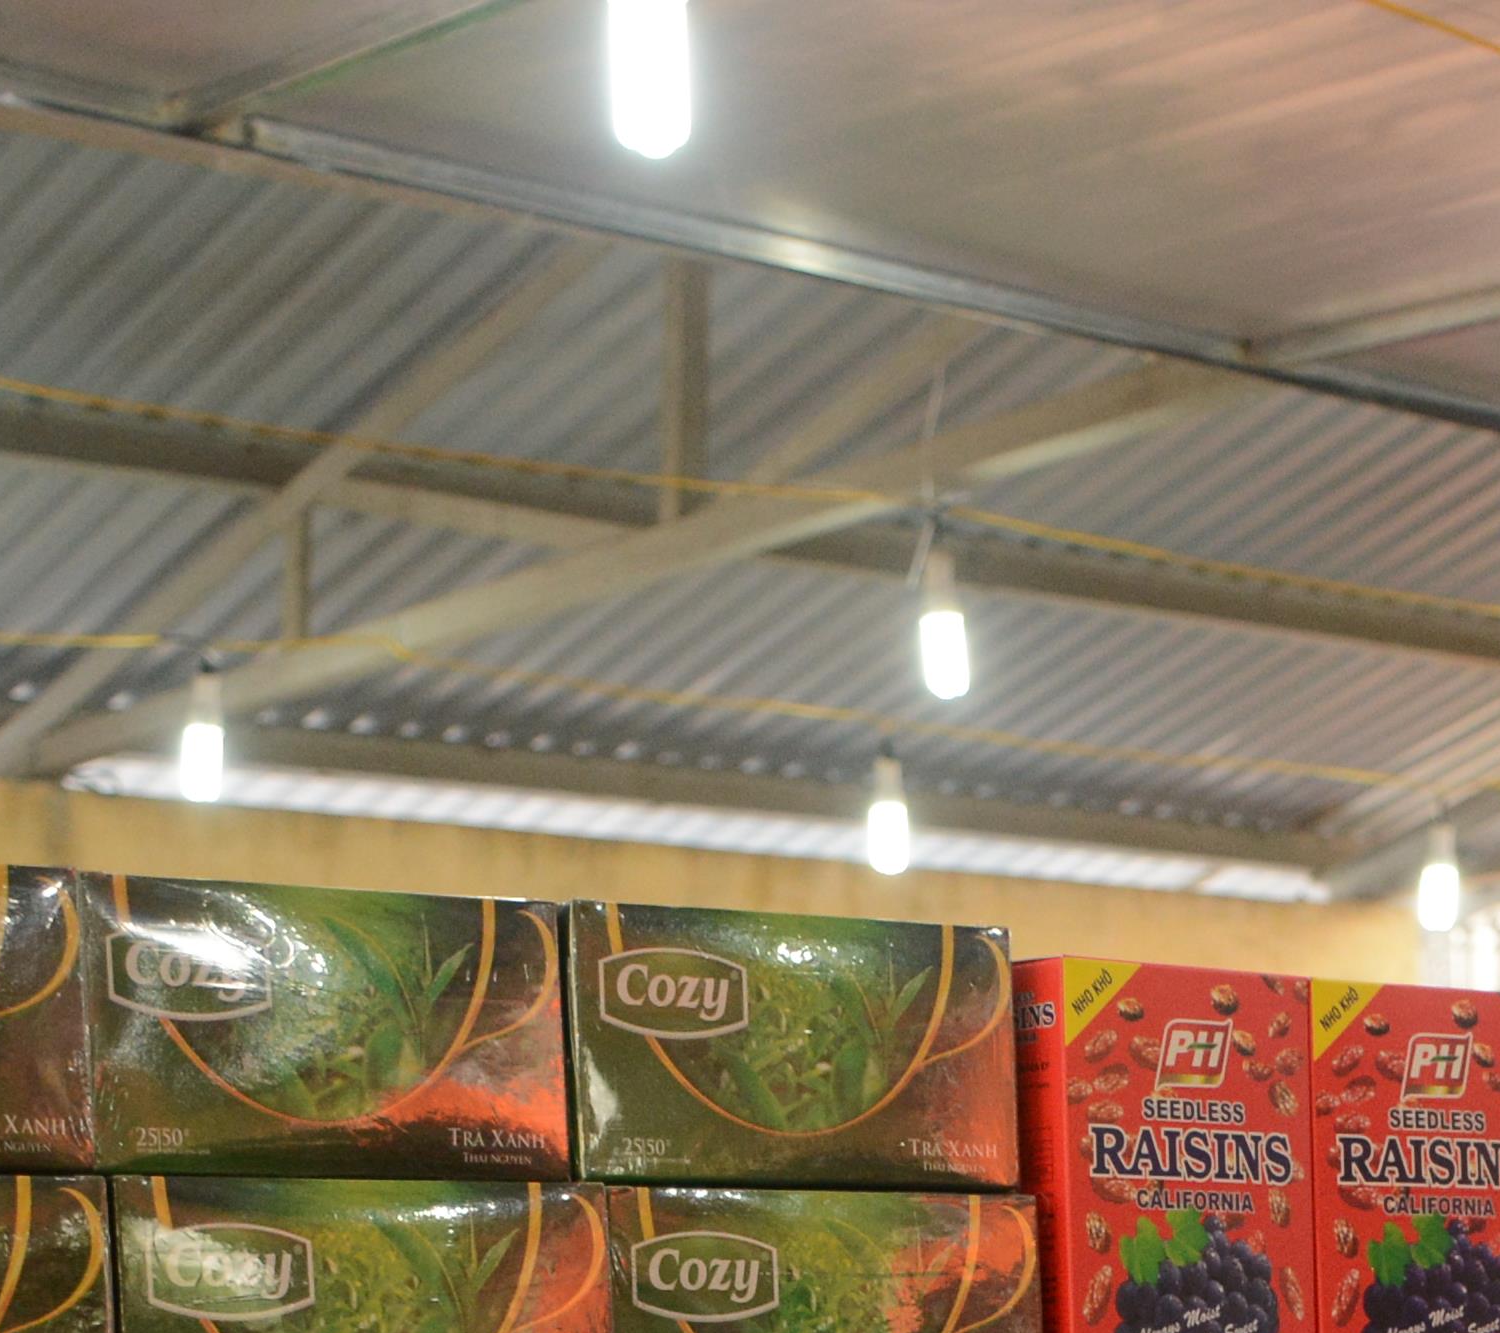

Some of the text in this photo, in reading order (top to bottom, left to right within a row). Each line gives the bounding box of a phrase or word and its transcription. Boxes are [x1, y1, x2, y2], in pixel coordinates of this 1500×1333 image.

[616, 964, 729, 1020] Cozy
[1143, 1097, 1244, 1124] SEEDLESS
[1389, 1108, 1485, 1132] SEEDLESS
[491, 1129, 546, 1149] XANH
[1091, 1124, 1293, 1185] RAISINS
[1135, 1188, 1254, 1213] CALIFORNIA
[1383, 1195, 1495, 1217] CALIFORNIA
[649, 1247, 759, 1302] Cozy
